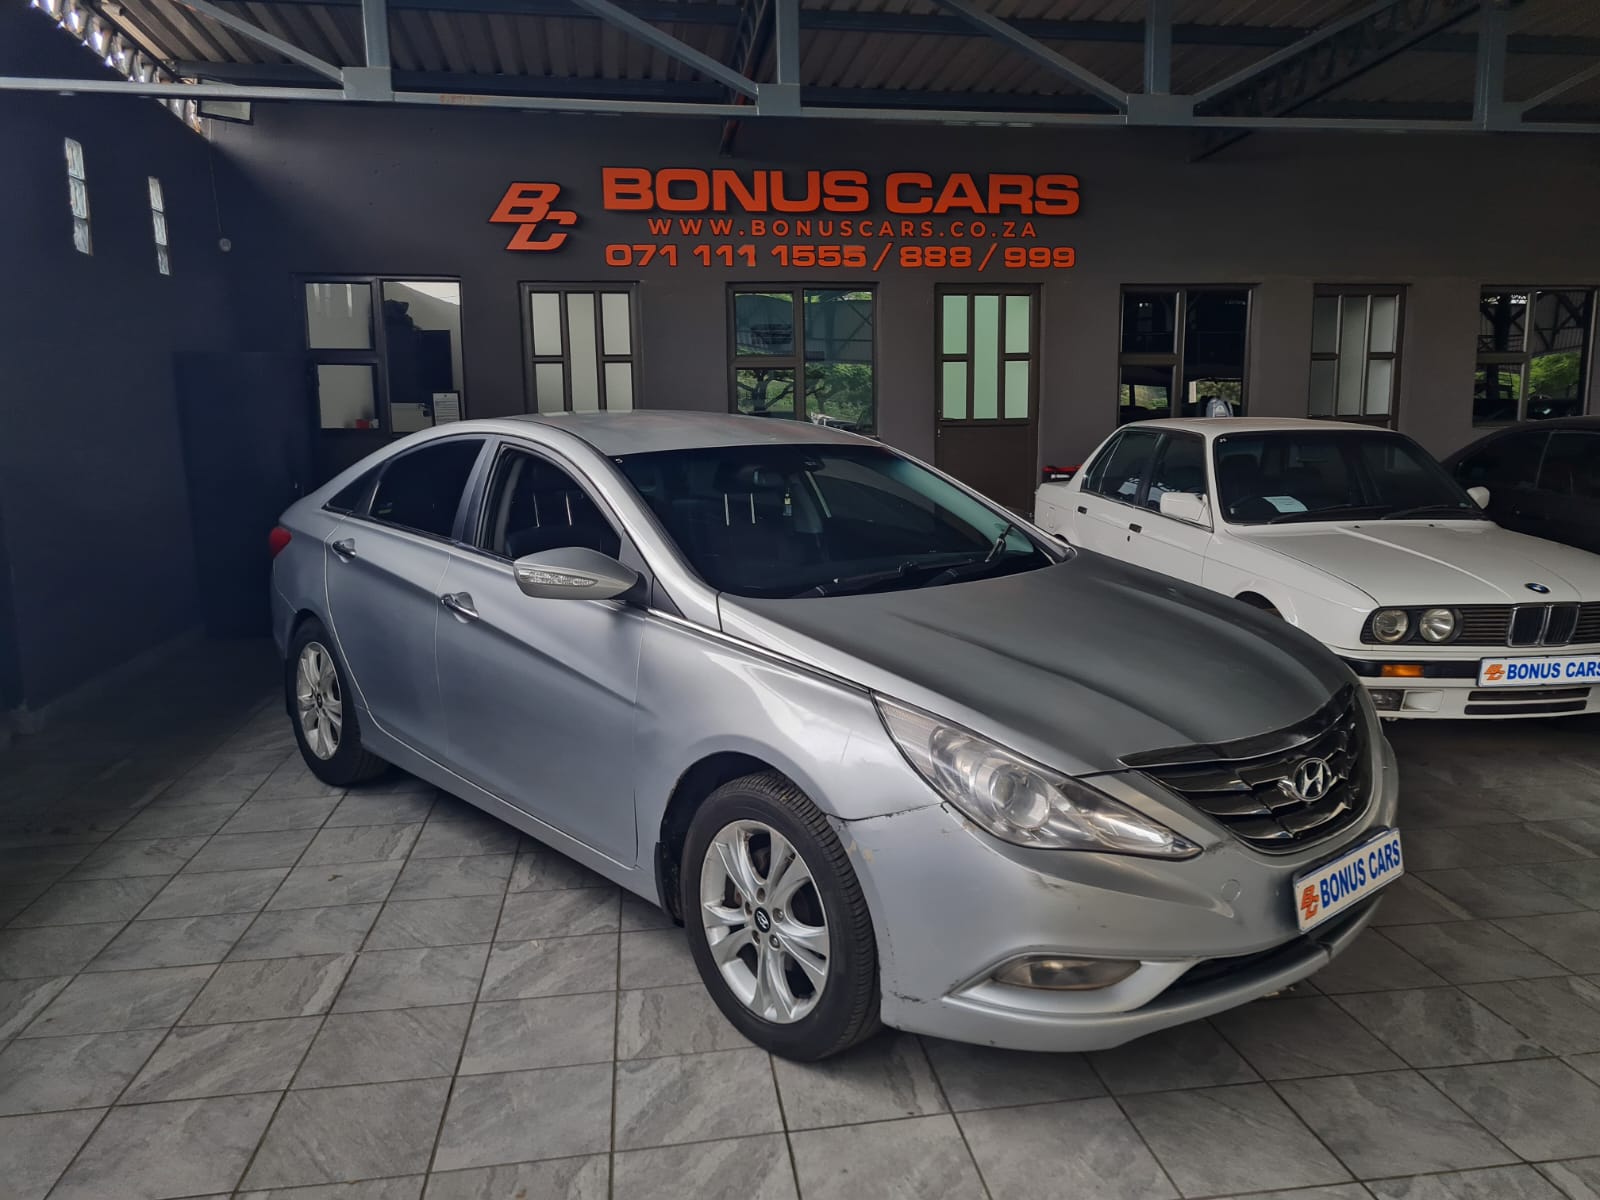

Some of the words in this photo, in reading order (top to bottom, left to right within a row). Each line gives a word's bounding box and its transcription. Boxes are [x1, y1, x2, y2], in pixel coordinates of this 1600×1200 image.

[602, 167, 870, 213] BONUS
[885, 172, 1080, 216] CARS
[647, 218, 1037, 239] WWW.BONUSCARS.CO.ZA
[604, 243, 678, 268] 071
[692, 244, 757, 268] 111
[1506, 662, 1561, 680] BONUS
[1319, 857, 1367, 909] BONUS
[1368, 839, 1401, 880] CARS
